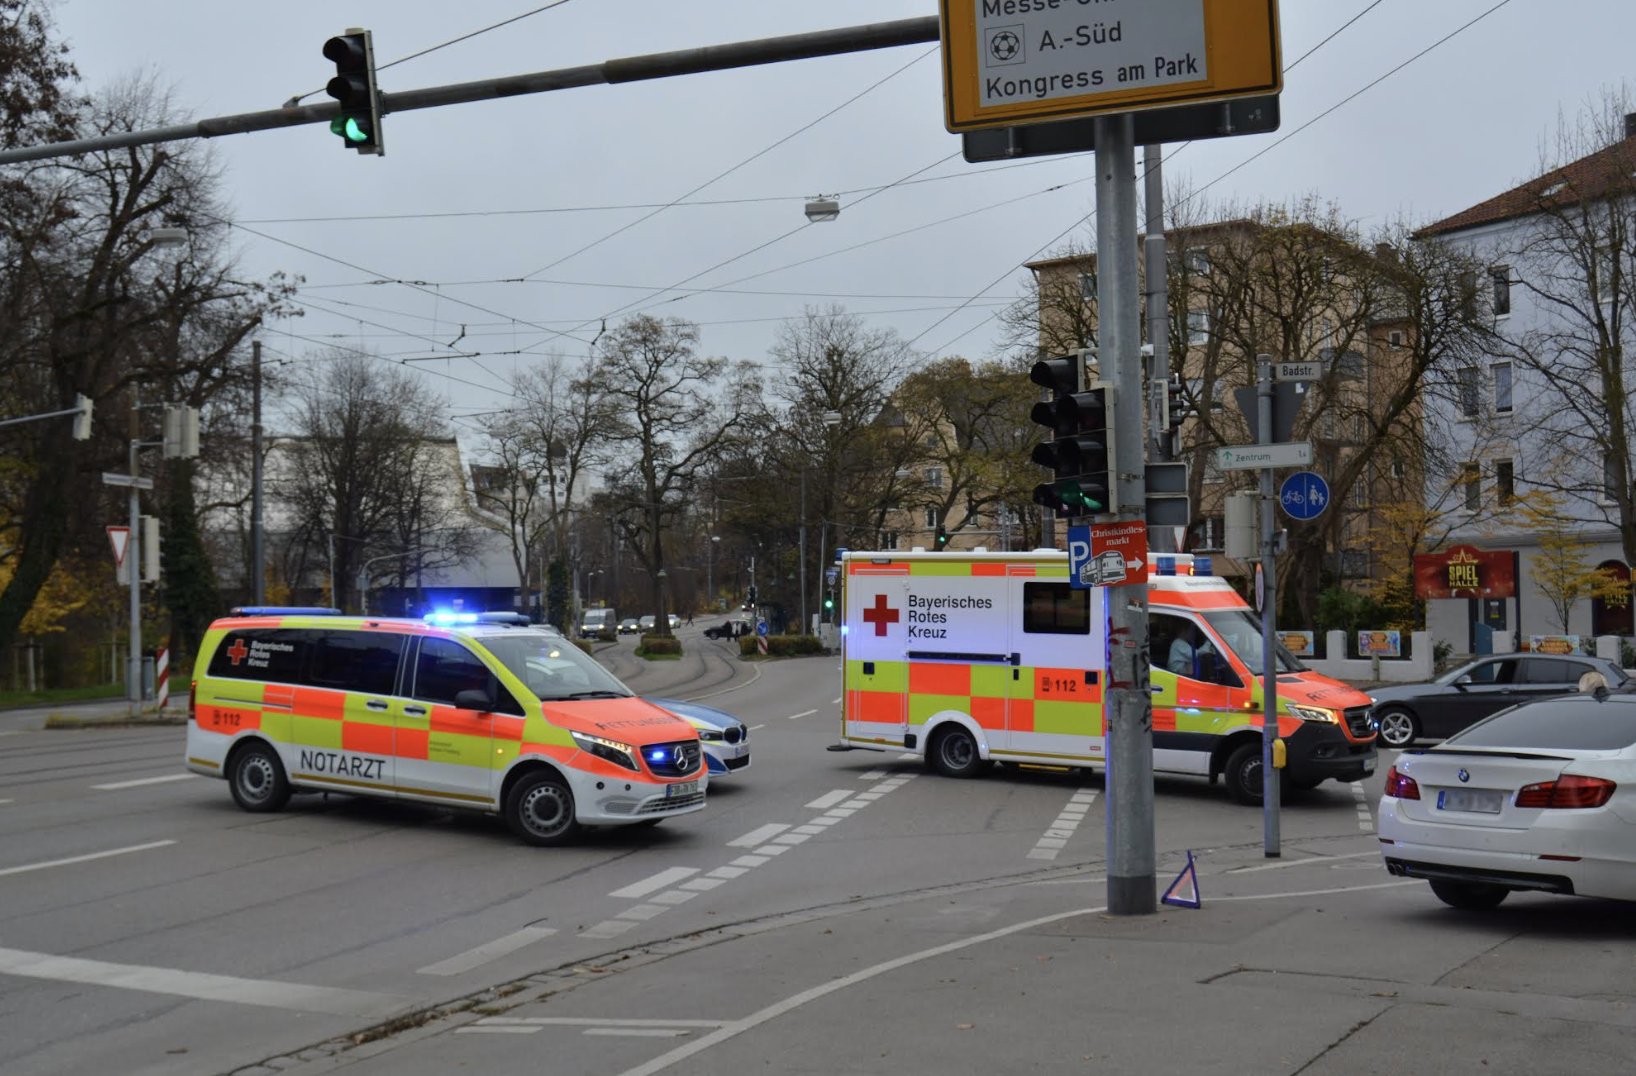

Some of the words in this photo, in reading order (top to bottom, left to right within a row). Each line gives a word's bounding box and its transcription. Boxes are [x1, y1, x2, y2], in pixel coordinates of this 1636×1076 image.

[1039, 21, 1122, 51] A.-Süd
[987, 69, 1104, 98] Kongress
[1118, 63, 1145, 83] am
[1154, 53, 1198, 78] Park
[1282, 365, 1315, 376] Badstr.
[1235, 454, 1271, 462] Zentrum
[1106, 537, 1130, 546] markt
[1069, 541, 1090, 575] P
[1449, 565, 1478, 580] SPIEL
[908, 594, 993, 611] Bayerisches
[908, 610, 947, 624] Rotes
[908, 625, 947, 639] Kreuz
[251, 640, 294, 652] Bayerisches
[250, 649, 271, 659] Rotes
[248, 658, 269, 668] Kreuz
[1055, 679, 1076, 692] 112
[223, 712, 241, 726] 112
[301, 750, 386, 780] NOTARZT
